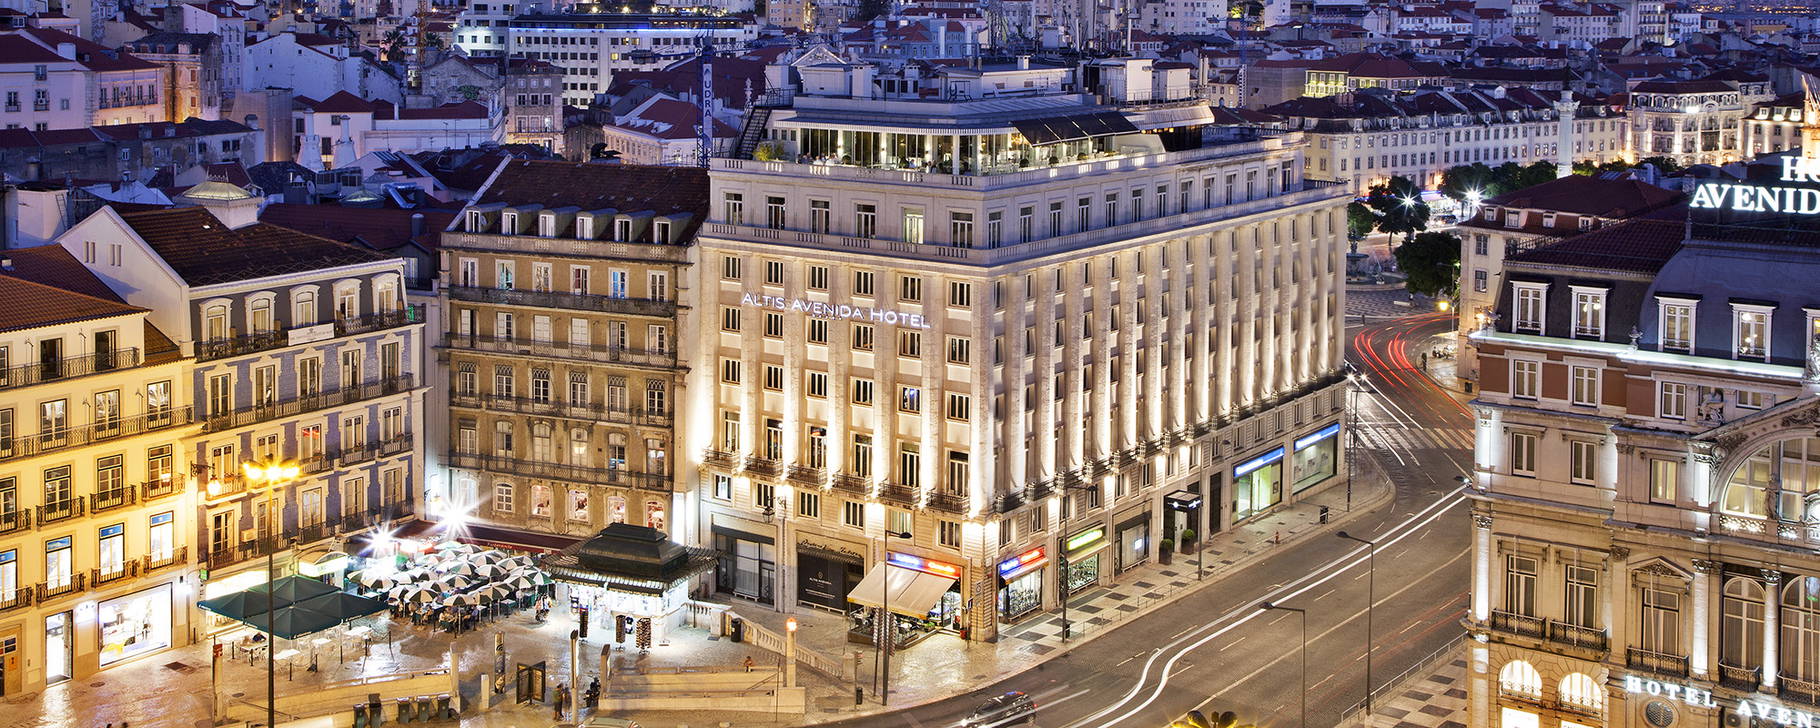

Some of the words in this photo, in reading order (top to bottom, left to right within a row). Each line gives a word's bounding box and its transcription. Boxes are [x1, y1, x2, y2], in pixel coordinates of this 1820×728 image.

[1689, 183, 1820, 215] AVENID
[741, 292, 786, 309] ALTIS
[791, 298, 865, 319] AVENIDA
[870, 308, 931, 329] HOTEL
[1625, 675, 1718, 708] HOTEL
[1736, 700, 1814, 728] AVEN
